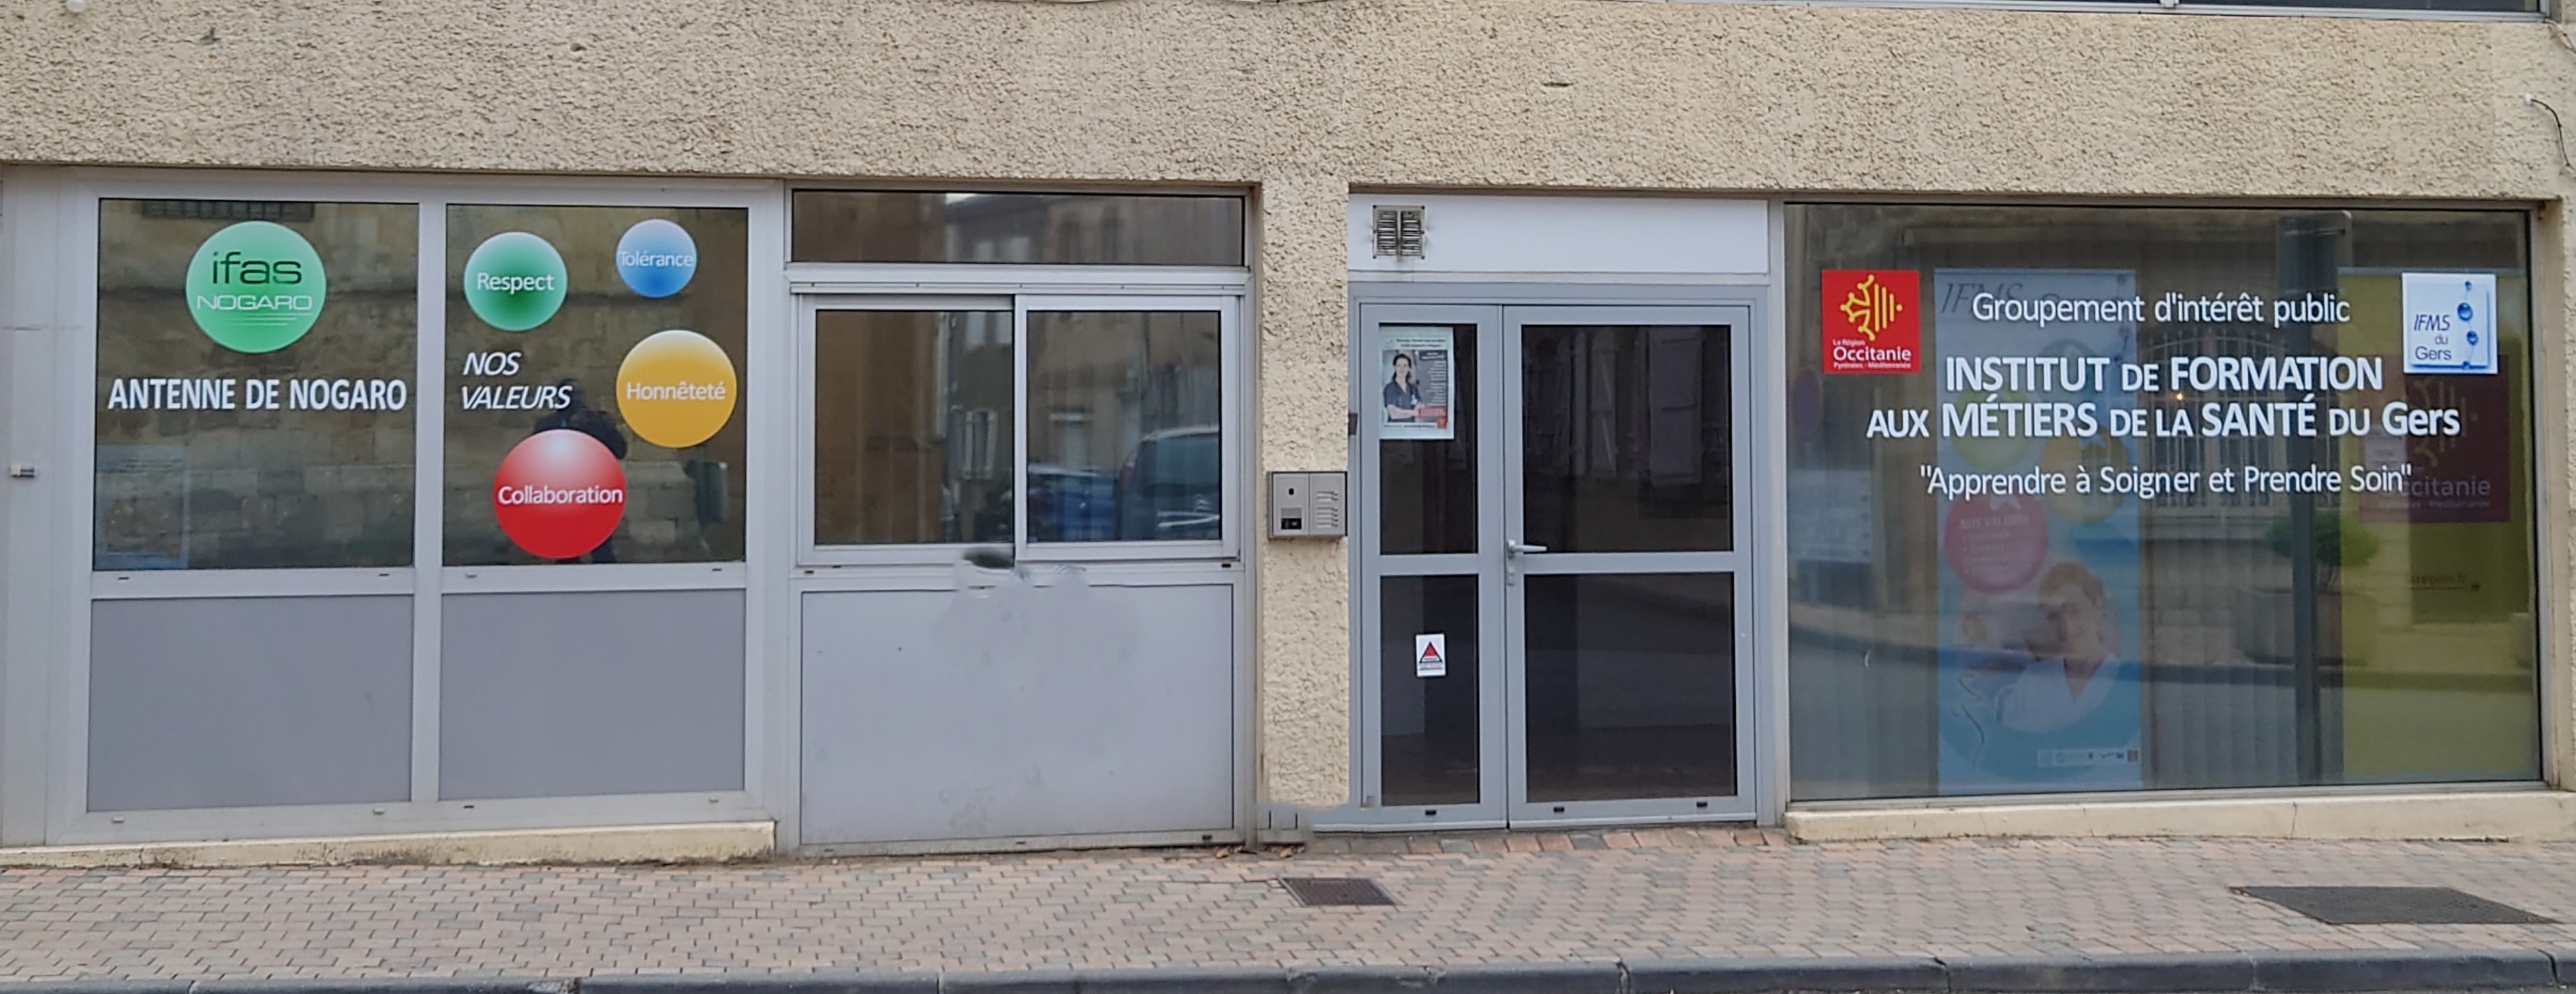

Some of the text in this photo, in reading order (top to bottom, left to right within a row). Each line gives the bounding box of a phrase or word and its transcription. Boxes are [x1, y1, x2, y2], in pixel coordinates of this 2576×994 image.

[211, 251, 303, 285] ifas
[619, 250, 694, 268] Tolérance
[477, 272, 554, 293] Respect
[197, 295, 313, 311] NOGARO
[1972, 292, 2144, 327] Groupement
[2155, 291, 2263, 323] d'intérêt
[2274, 293, 2350, 328] public
[2414, 314, 2450, 331] IFMS
[2435, 334, 2448, 345] du
[463, 352, 521, 375] NOS
[1833, 346, 1912, 361] Occitanie
[2415, 346, 2452, 361] Gers
[1946, 356, 2383, 392] INSTITUT DE FORMATION
[108, 378, 407, 411] ANTENNE DE NOGARO
[462, 385, 572, 409] VALEURS
[626, 383, 725, 401] Honnêteté
[1866, 393, 2461, 438] AUX MÉTIERS DE LA SANTÉ DU Gers
[1920, 464, 2411, 499] "Apprendre à Soigner et Prendre Soin"
[498, 485, 623, 505] Collaboration
